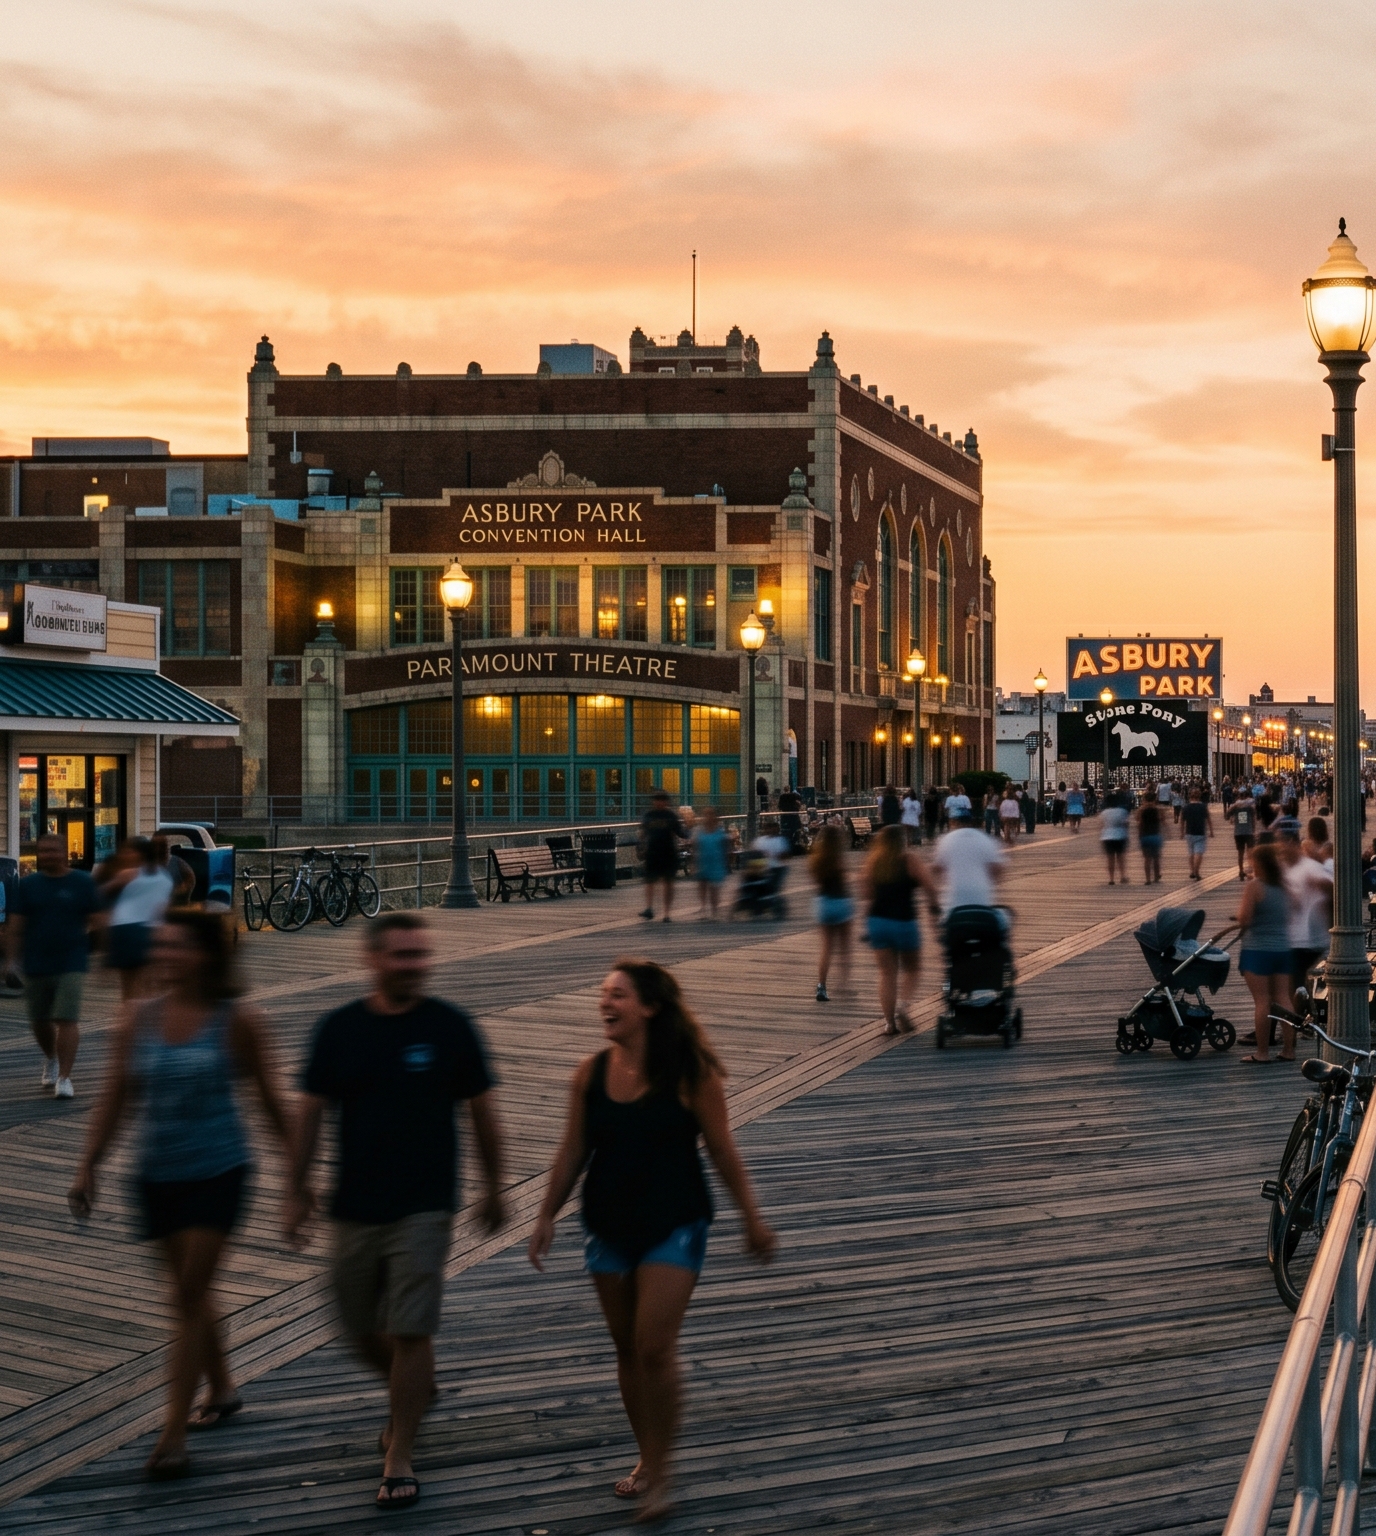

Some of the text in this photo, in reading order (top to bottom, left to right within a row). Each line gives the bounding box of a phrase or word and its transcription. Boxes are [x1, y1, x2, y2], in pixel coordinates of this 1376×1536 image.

[461, 503, 642, 523] ASBURY PARK
[459, 528, 646, 543] CONVENTION HALL
[570, 653, 677, 679] THEATRE
[1072, 642, 1214, 679] ASBURY
[1139, 675, 1214, 696] PARK
[1139, 702, 1187, 729] Pony
